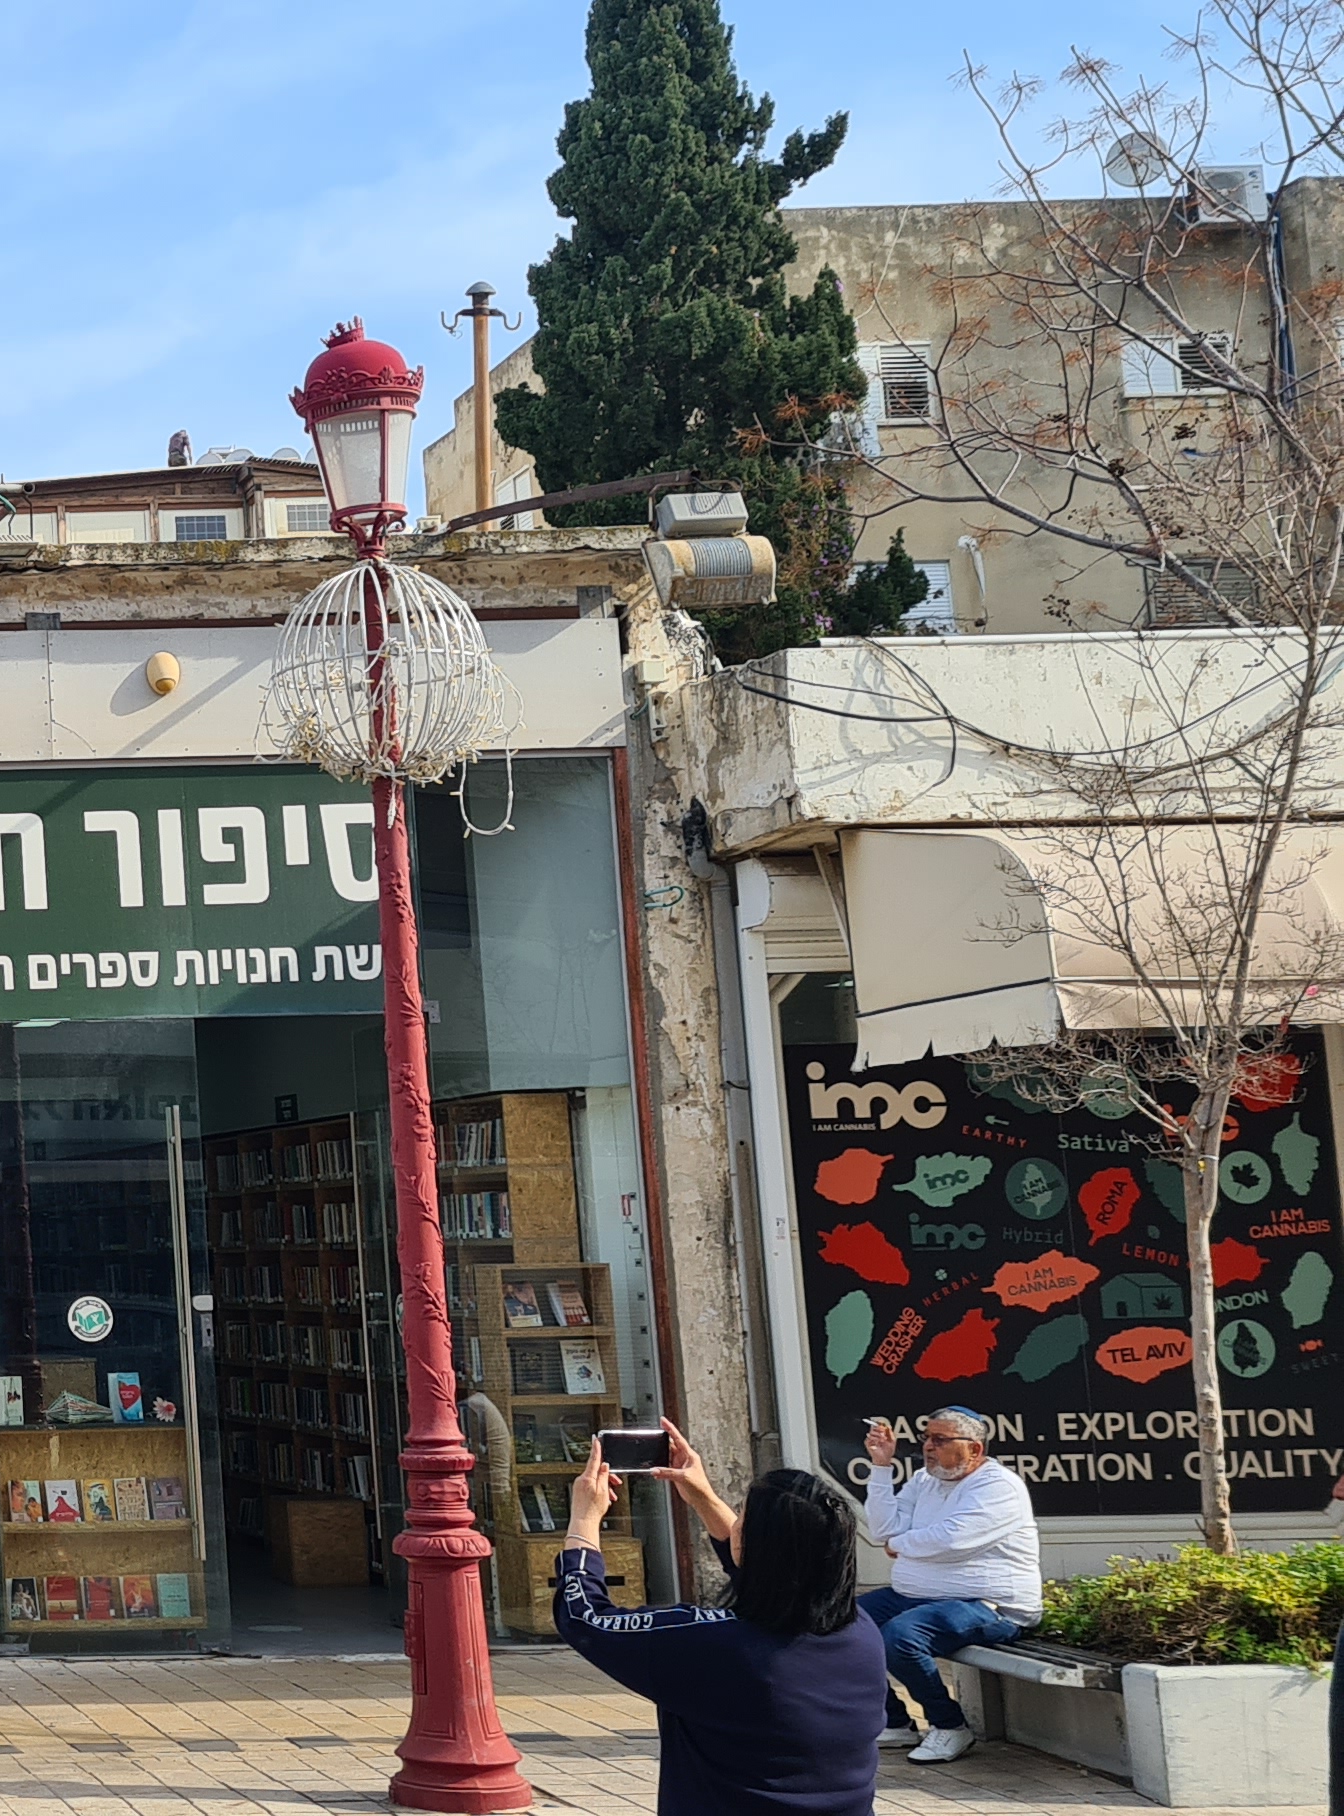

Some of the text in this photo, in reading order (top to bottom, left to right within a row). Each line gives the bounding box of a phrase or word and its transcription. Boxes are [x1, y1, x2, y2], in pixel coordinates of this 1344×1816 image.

[84, 803, 380, 908] סיפור
[28, 951, 160, 990] ספרים
[173, 946, 300, 987] חנויות
[312, 943, 383, 982] שת
[806, 1061, 948, 1131] imc
[817, 1123, 832, 1132] AM
[833, 1122, 877, 1132] CANNABIS
[961, 1124, 1028, 1149] EARTHY
[1058, 1133, 1131, 1153] Sativa
[923, 1168, 970, 1190] imc
[1095, 1179, 1129, 1226] ROMA
[1270, 1207, 1304, 1223] I AM
[908, 1212, 987, 1250] imc
[1002, 1227, 1064, 1246] Hybrid
[1248, 1218, 1332, 1240] CANNABIS
[1121, 1242, 1181, 1267] LEMON
[1007, 1275, 1079, 1297] CANNABIS
[1025, 1268, 1054, 1281] I AM
[921, 1271, 981, 1307] HERBAL
[1212, 1289, 1270, 1314] NDON
[869, 1306, 917, 1368] WEDDING
[881, 1313, 928, 1375] CRASHER
[1107, 1340, 1187, 1365] TEL AVIV
[869, 1413, 1025, 1443] ASON
[1058, 1408, 1316, 1442] EXPLORTION
